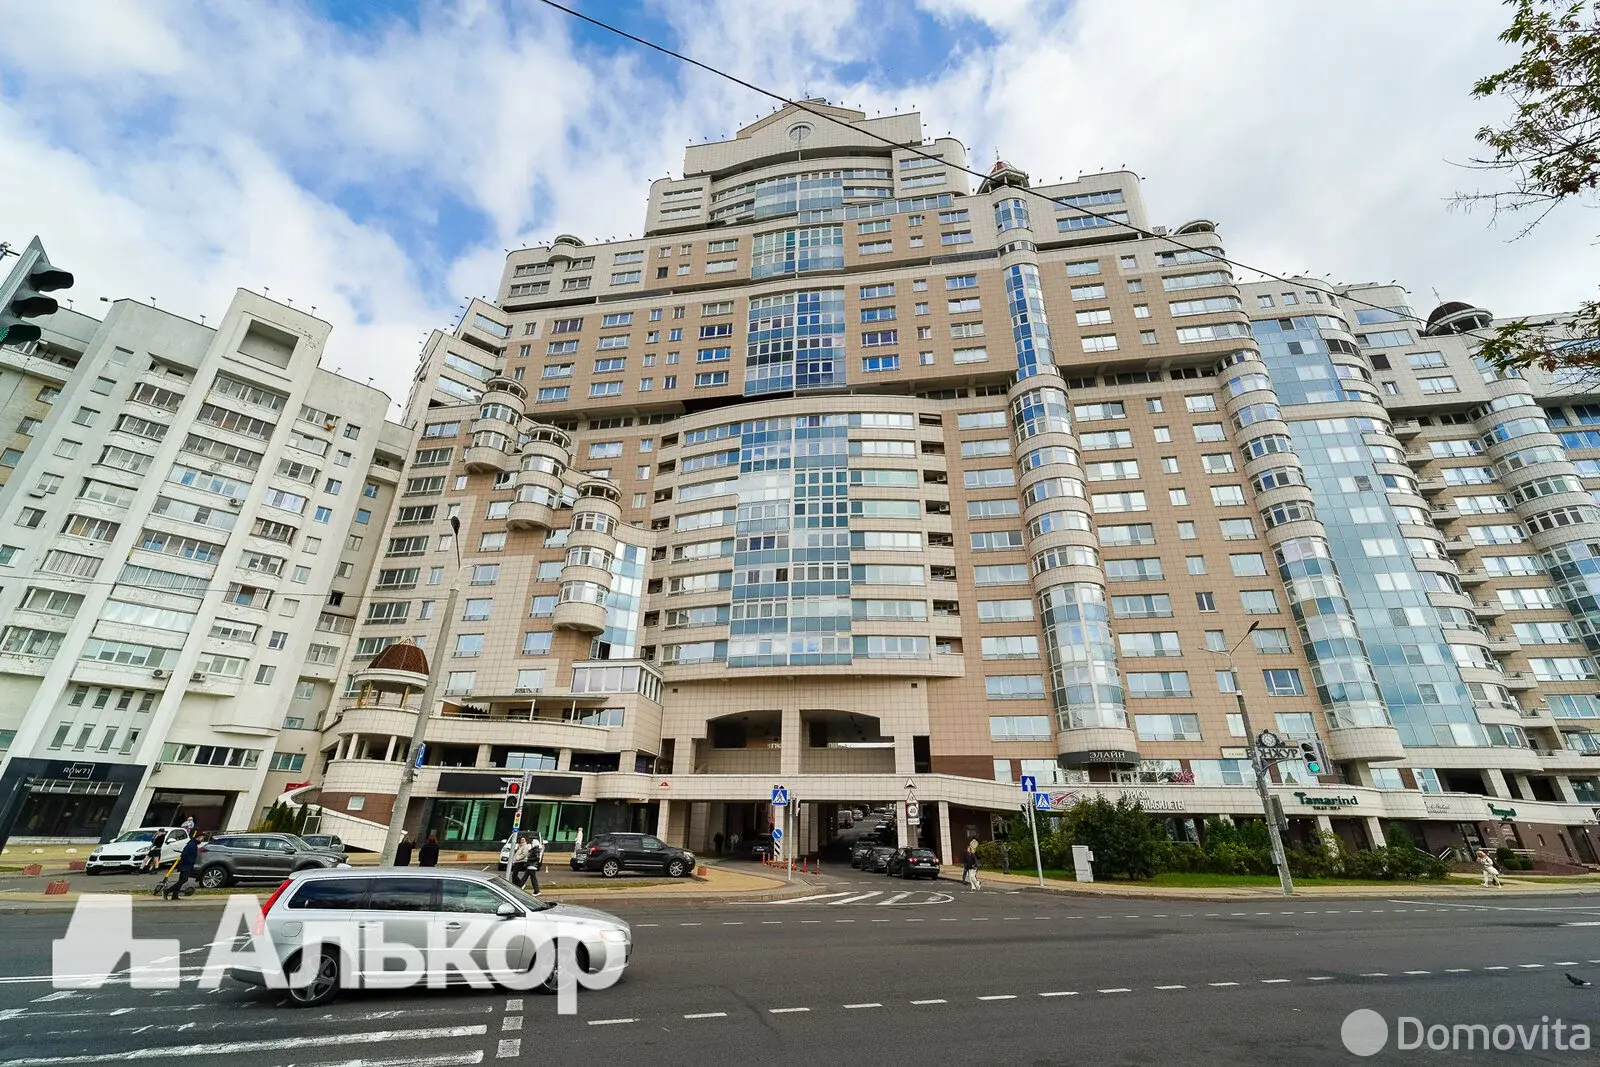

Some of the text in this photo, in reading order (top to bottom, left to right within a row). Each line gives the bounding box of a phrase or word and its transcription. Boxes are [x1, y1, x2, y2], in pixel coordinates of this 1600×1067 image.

[1089, 750, 1125, 758] ЭЛАЙН
[1246, 748, 1298, 759] БНЖУР
[1293, 792, 1359, 805] Tamarind
[1136, 800, 1186, 810] ВИАБИЛЕТЫ
